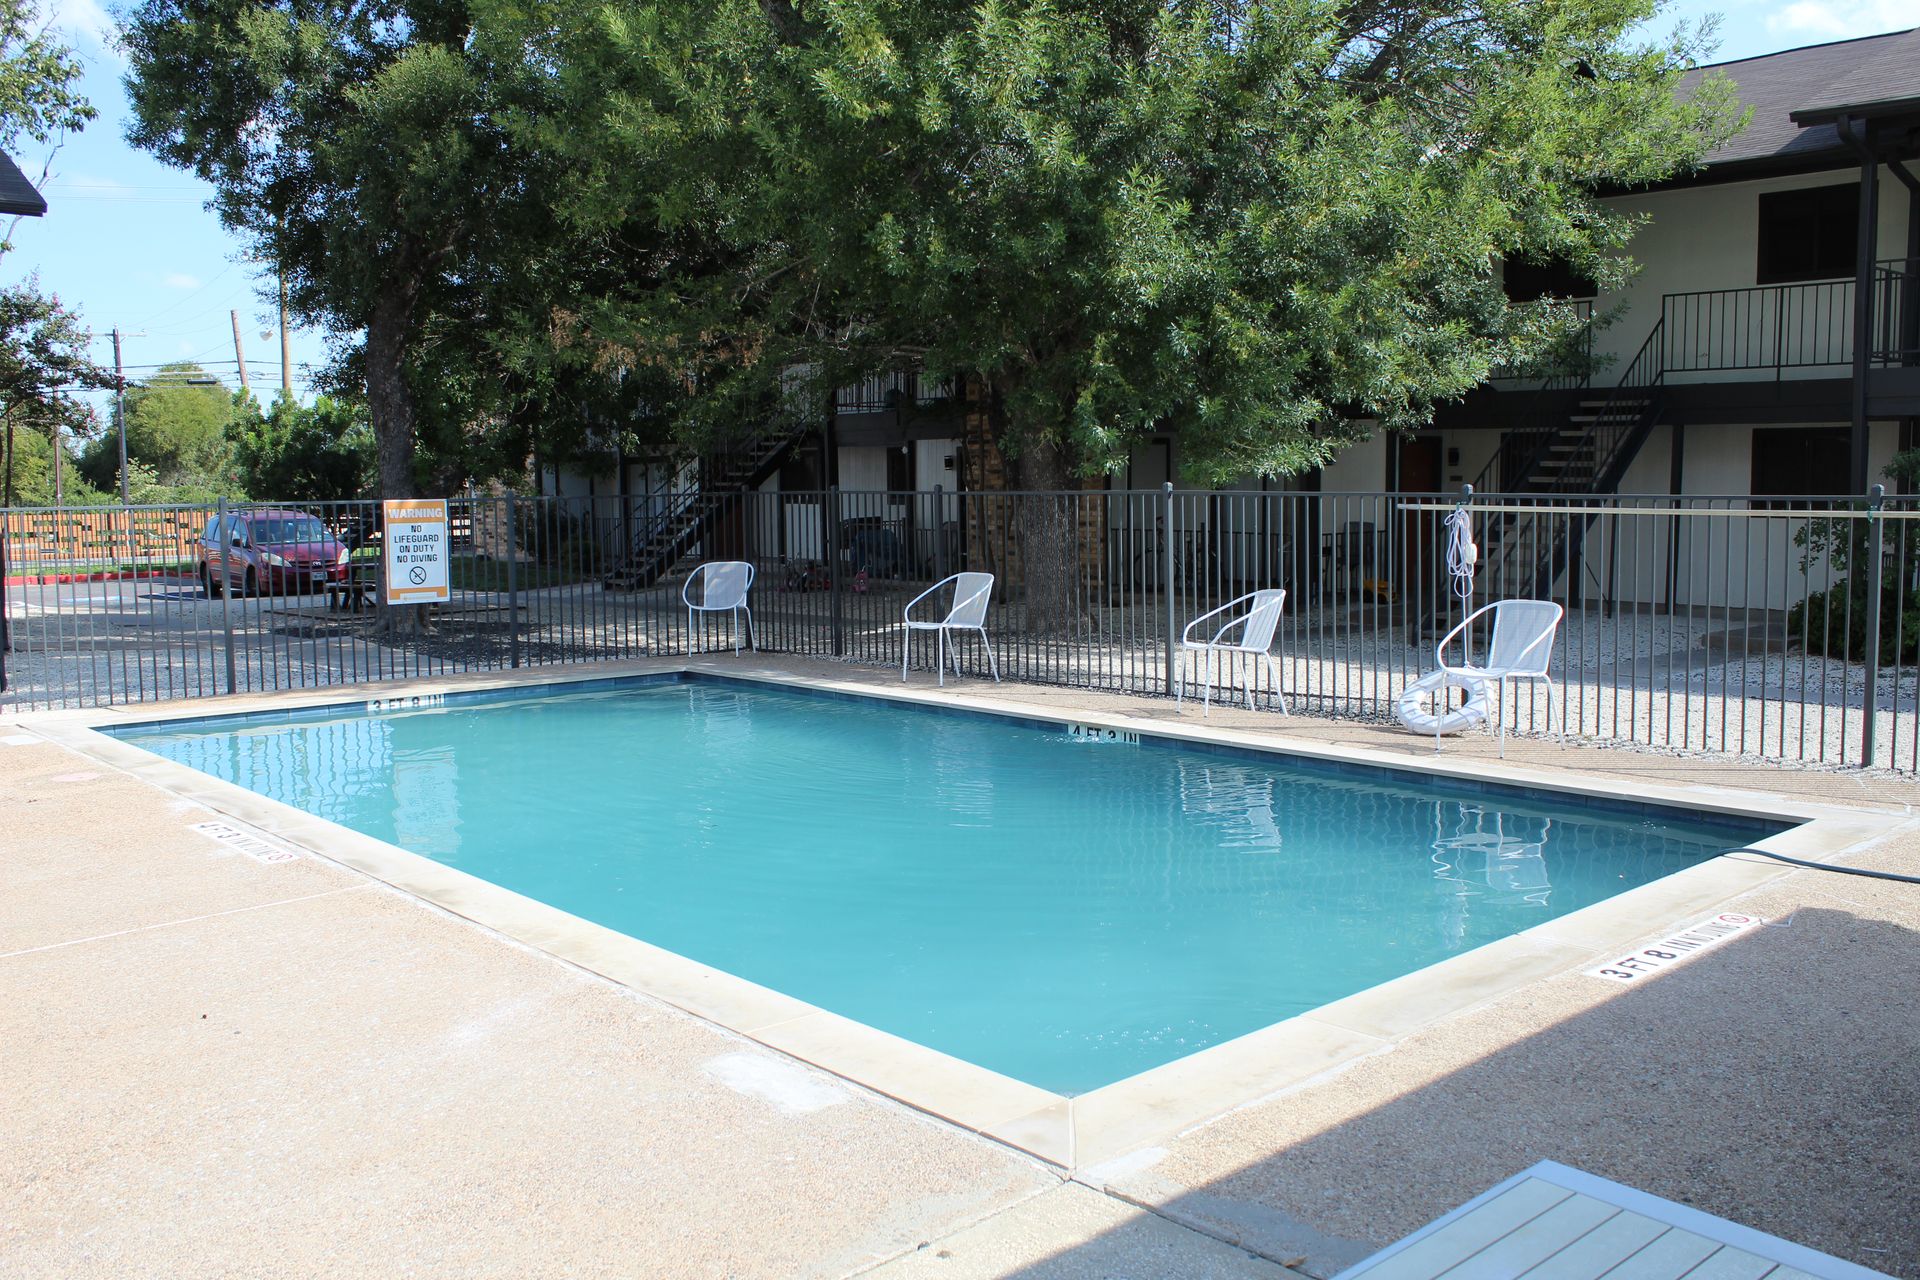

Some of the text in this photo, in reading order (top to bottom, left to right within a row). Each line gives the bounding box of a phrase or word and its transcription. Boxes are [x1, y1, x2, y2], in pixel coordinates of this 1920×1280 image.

[388, 507, 443, 518] WARNING
[394, 534, 439, 543] LIFEGUARD
[399, 544, 434, 553] ON DUTY
[396, 554, 438, 563] NO DIVING
[1086, 727, 1102, 737] FT
[1123, 731, 1137, 743] IN
[1643, 949, 1678, 960] 8
[1616, 957, 1660, 972] FT
[1599, 969, 1634, 979] 3
